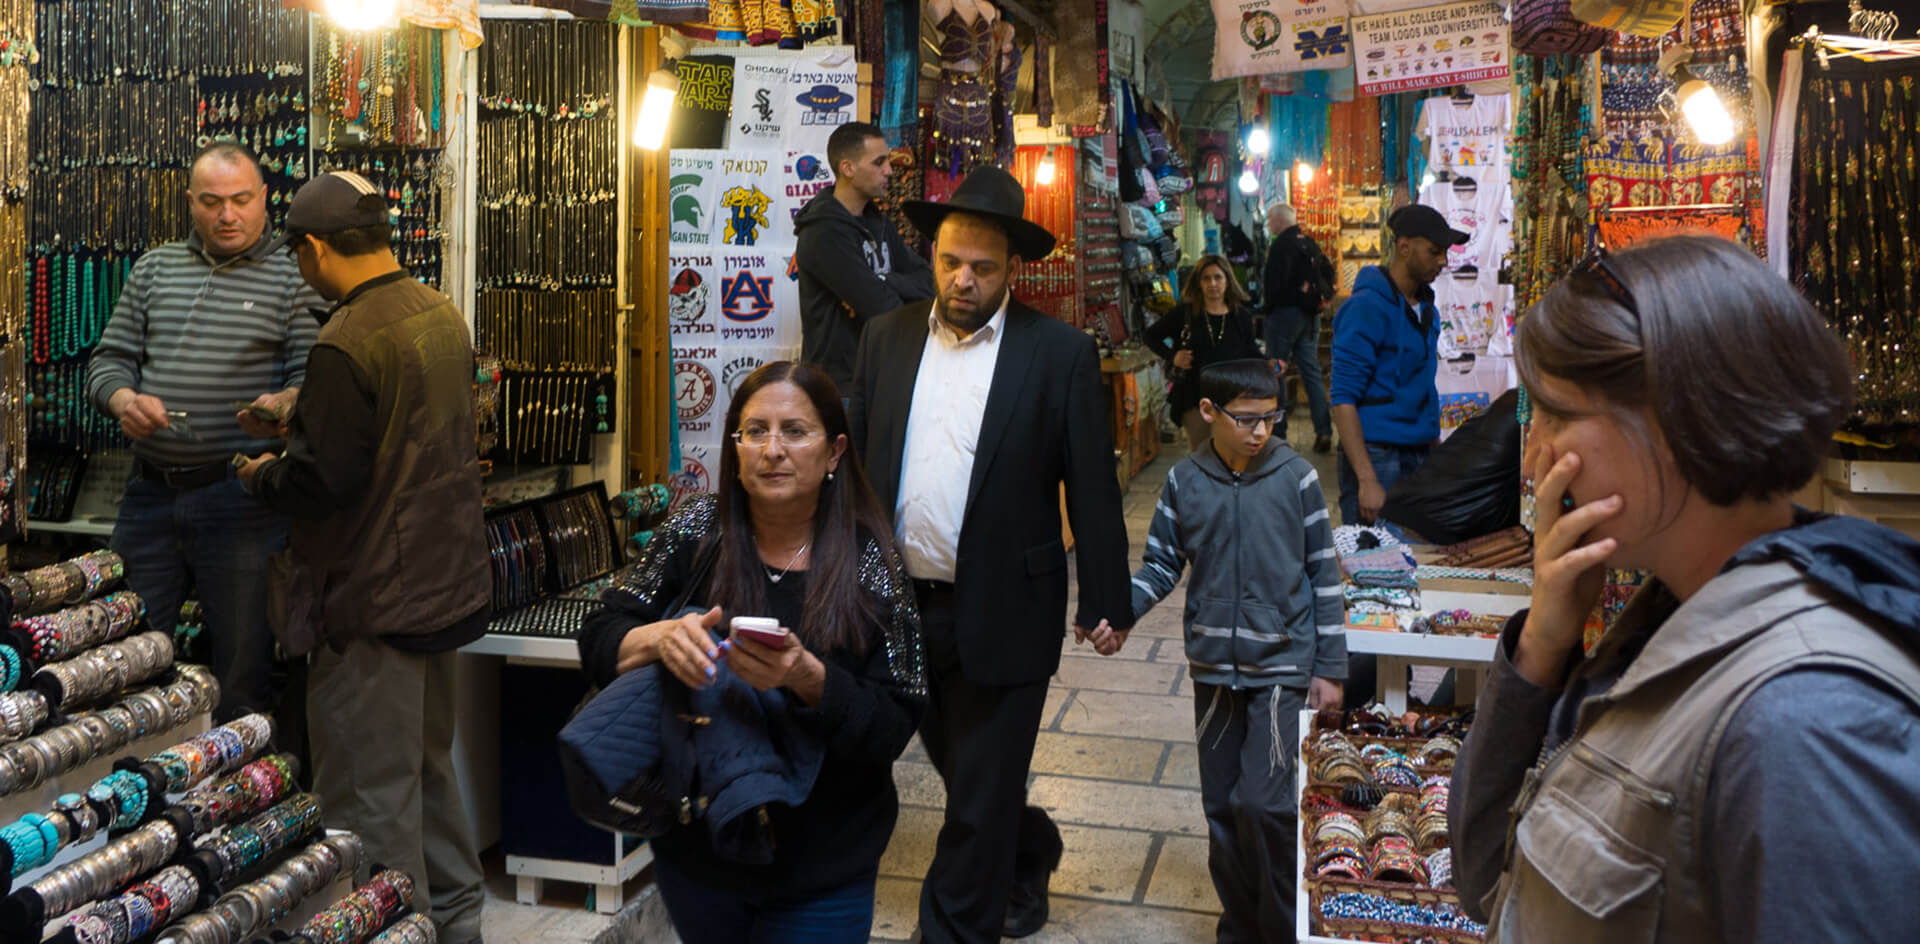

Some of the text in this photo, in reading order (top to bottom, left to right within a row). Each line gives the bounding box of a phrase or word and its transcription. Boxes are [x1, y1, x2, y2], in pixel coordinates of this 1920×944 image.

[1355, 21, 1368, 32] WE
[1369, 17, 1391, 30] HAVE
[1393, 15, 1407, 27] ALL
[1410, 10, 1448, 25] COLLEGE
[1450, 7, 1467, 18] AND
[1369, 30, 1390, 44] TEAM
[1393, 26, 1421, 41] LOGOS
[1423, 23, 1440, 36] AND
[1442, 17, 1489, 34] UNIVERSITY
[744, 64, 788, 74] CHICAGO
[678, 80, 732, 103] ARS
[1365, 84, 1379, 93] WE
[1382, 81, 1402, 91] WILL
[1405, 77, 1431, 88] MAKE
[1434, 74, 1451, 84] ANY
[1438, 126, 1498, 137] JERUSALEM
[721, 159, 768, 177] קנטאקי
[689, 232, 709, 245] STATE
[724, 256, 766, 271] אובורן
